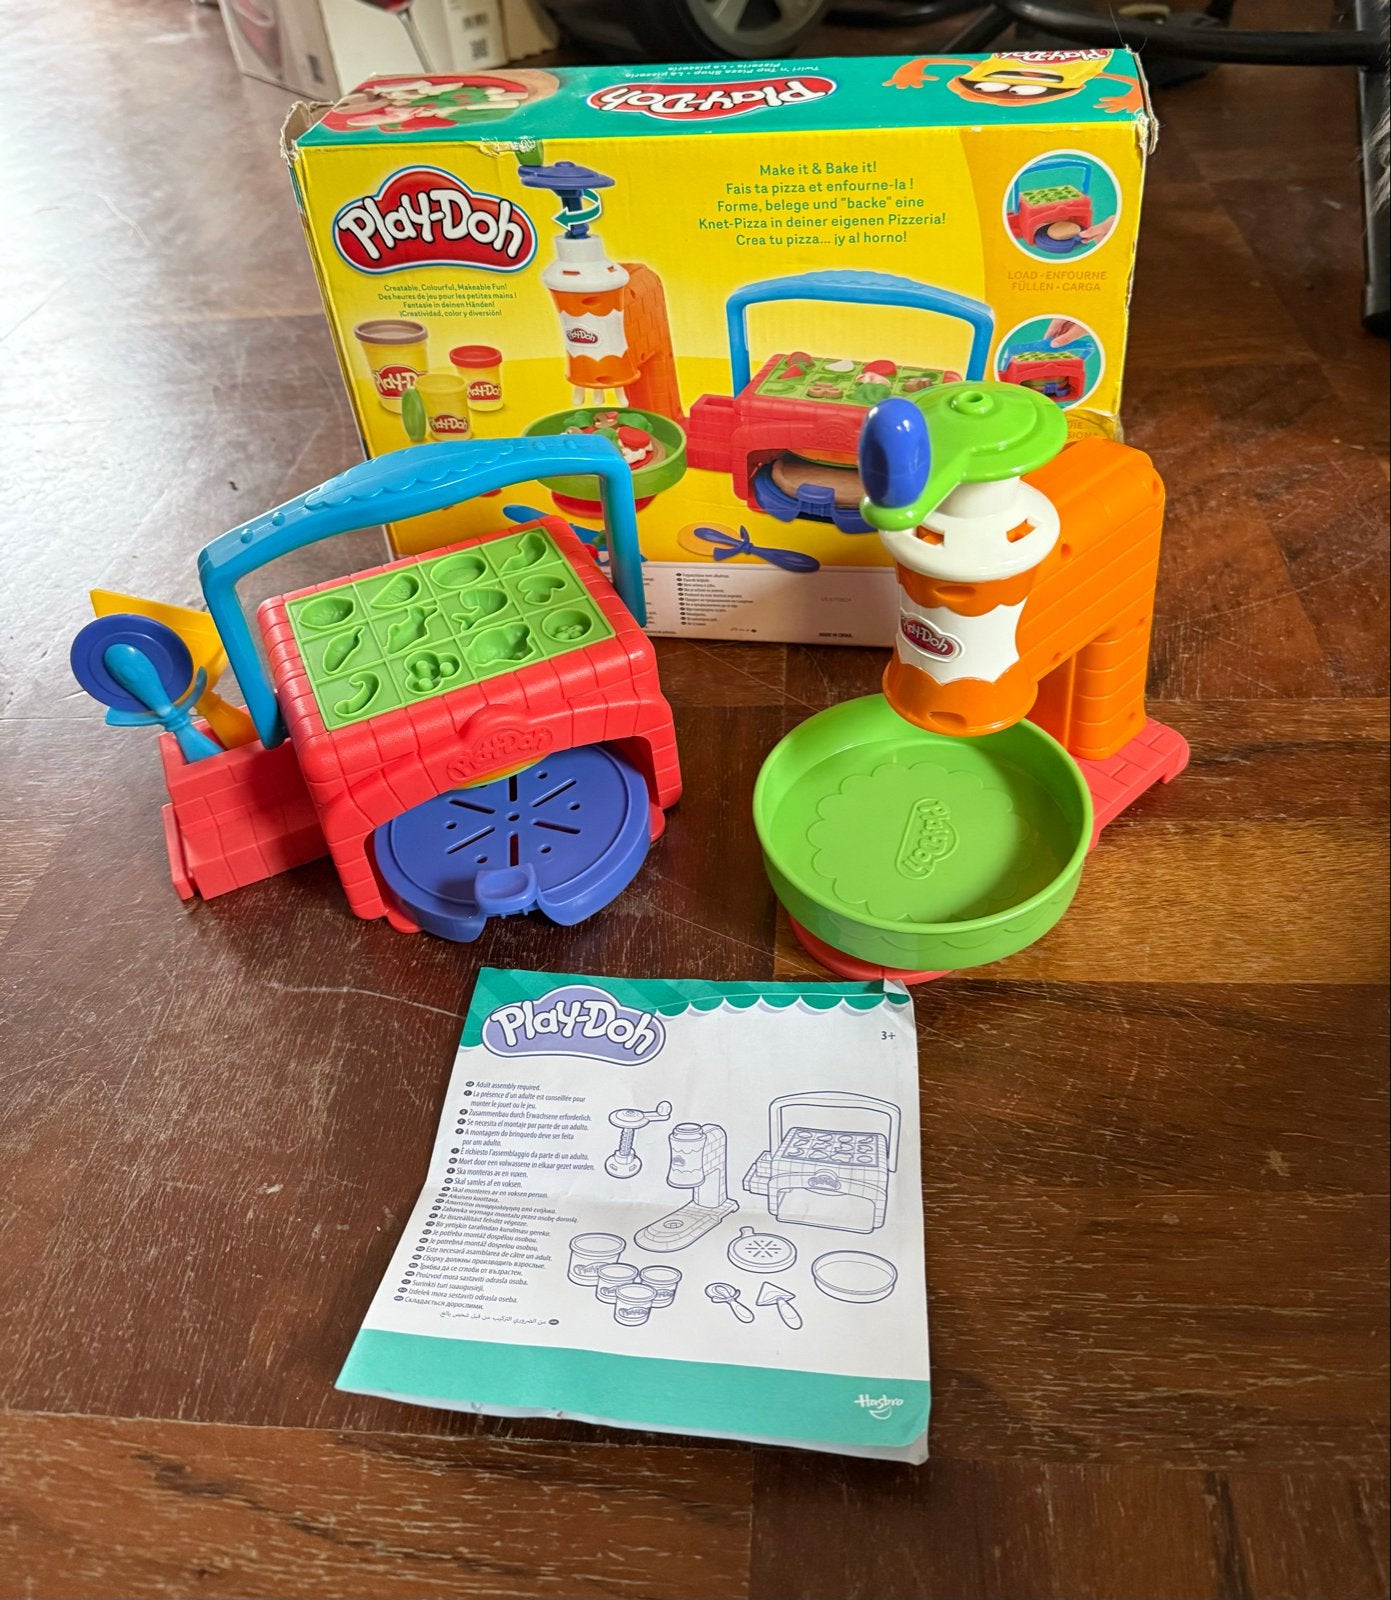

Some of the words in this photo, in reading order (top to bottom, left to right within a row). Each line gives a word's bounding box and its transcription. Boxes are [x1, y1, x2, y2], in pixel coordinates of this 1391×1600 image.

[600, 80, 828, 111] Play-Doh
[759, 164, 795, 176] Make
[798, 164, 809, 174] it
[812, 163, 822, 175] &
[826, 162, 858, 174] Bake
[862, 161, 877, 173] it!
[726, 182, 752, 194] Fais
[754, 183, 768, 194] ta
[771, 181, 806, 196] pizza
[809, 182, 823, 192] et
[826, 178, 906, 192] enfourne-la
[717, 200, 762, 213] Forme,
[765, 199, 809, 213] belege
[813, 198, 838, 210] und
[841, 196, 892, 209] "backe"
[896, 197, 924, 208] eine
[337, 188, 524, 262] Play-Doh
[699, 217, 768, 229] Knet-Pizza
[770, 217, 783, 228] in
[786, 216, 828, 228] deiner
[831, 216, 885, 229] eigenen
[888, 213, 946, 226] Pizzeria!
[736, 234, 766, 246] Crea
[769, 234, 783, 245] tu
[786, 233, 831, 247] pizza...
[834, 234, 845, 246] ¡y
[848, 231, 860, 243] al
[863, 231, 907, 243] horno!
[1008, 271, 1038, 280] LOAD
[1046, 271, 1107, 280] ENFOURNE
[1012, 281, 1054, 291] FÜLLEN
[1062, 282, 1100, 291] CARGA
[490, 1000, 656, 1056] Play-Doh
[881, 1031, 896, 1040] 3+
[469, 1109, 509, 1118] Zusammenbau
[509, 1131, 537, 1139] brinquedo
[489, 1149, 530, 1159] l'assemblaggio
[854, 1394, 904, 1410] Hasbro
